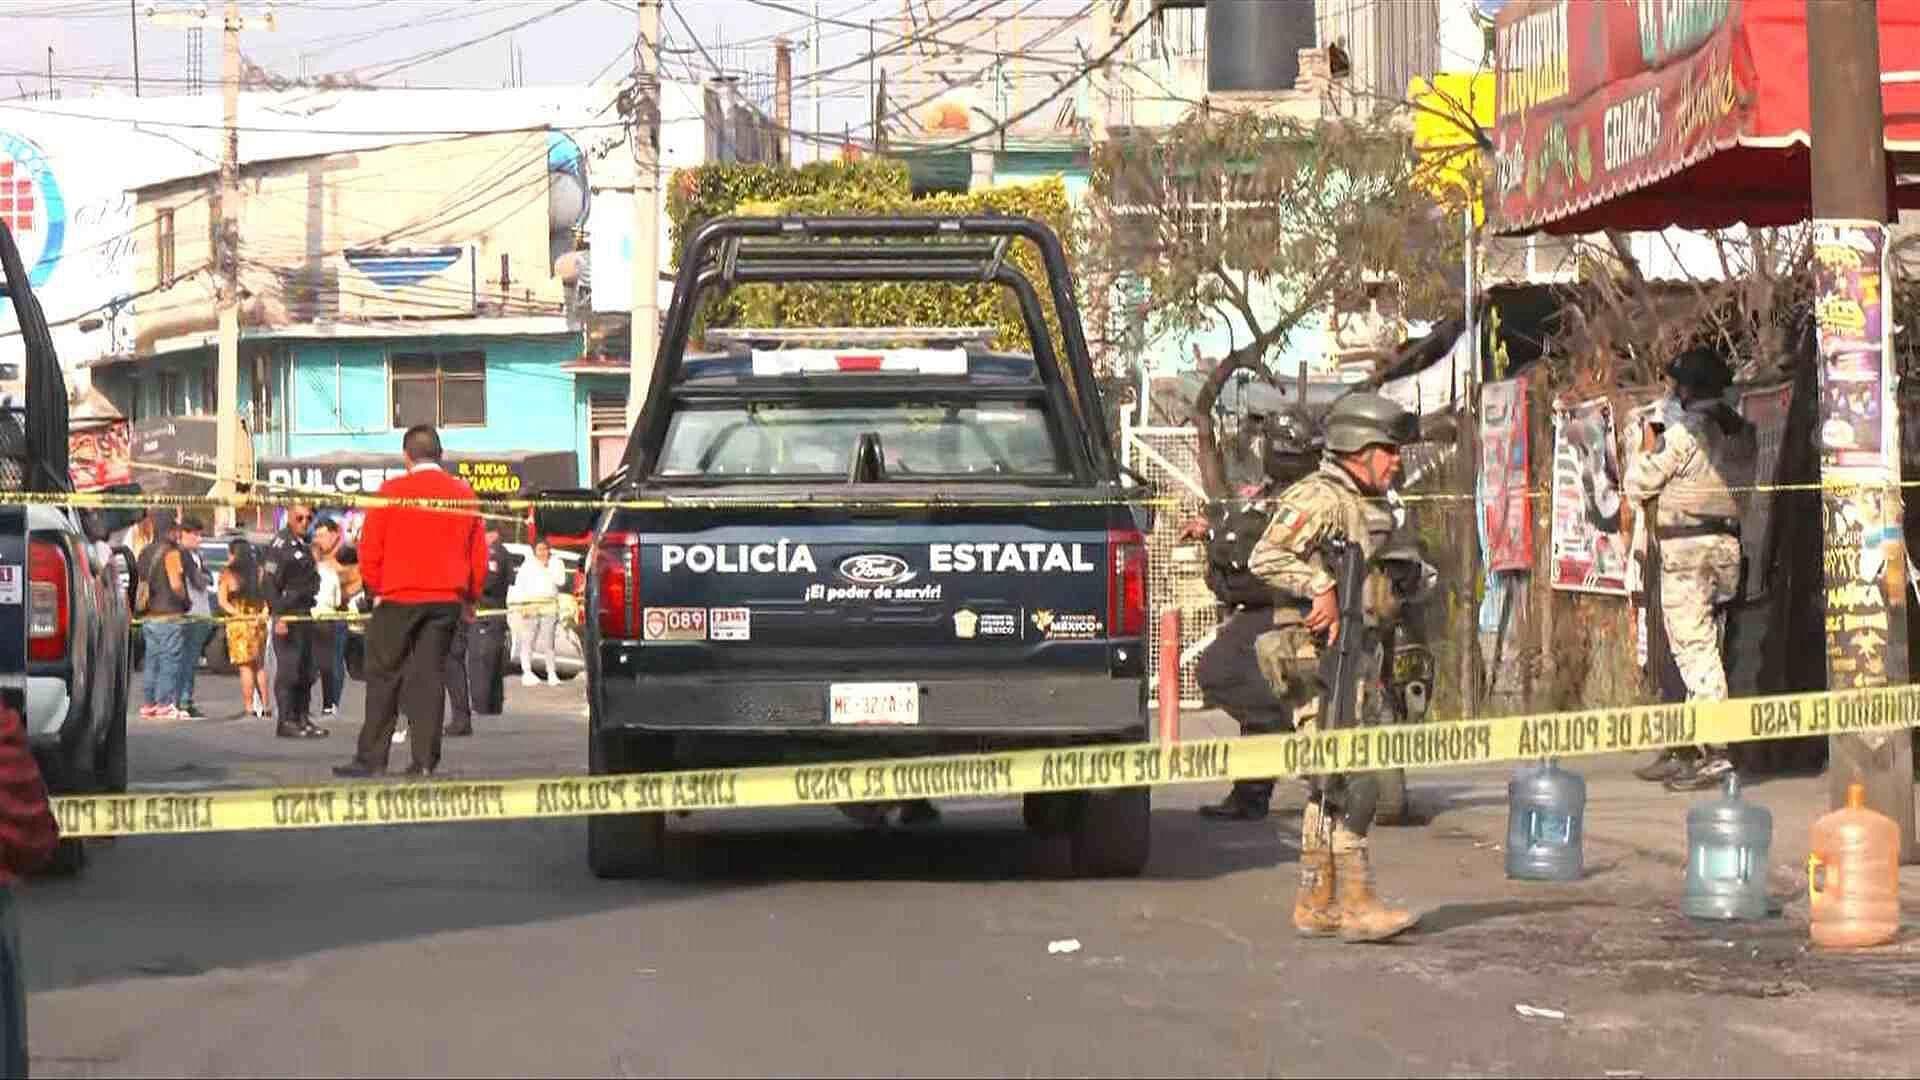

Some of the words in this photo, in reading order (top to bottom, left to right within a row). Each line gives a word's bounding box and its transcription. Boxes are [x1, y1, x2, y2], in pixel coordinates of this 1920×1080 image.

[1495, 3, 1569, 115] TAQUERIA
[1604, 88, 1661, 171] GRINGAS
[662, 537, 816, 573] POLICÍA
[929, 543, 1094, 572] ESTATAL
[851, 559, 896, 577] Ford
[827, 584, 871, 602] poder
[874, 584, 892, 599] de
[669, 611, 702, 629] 089
